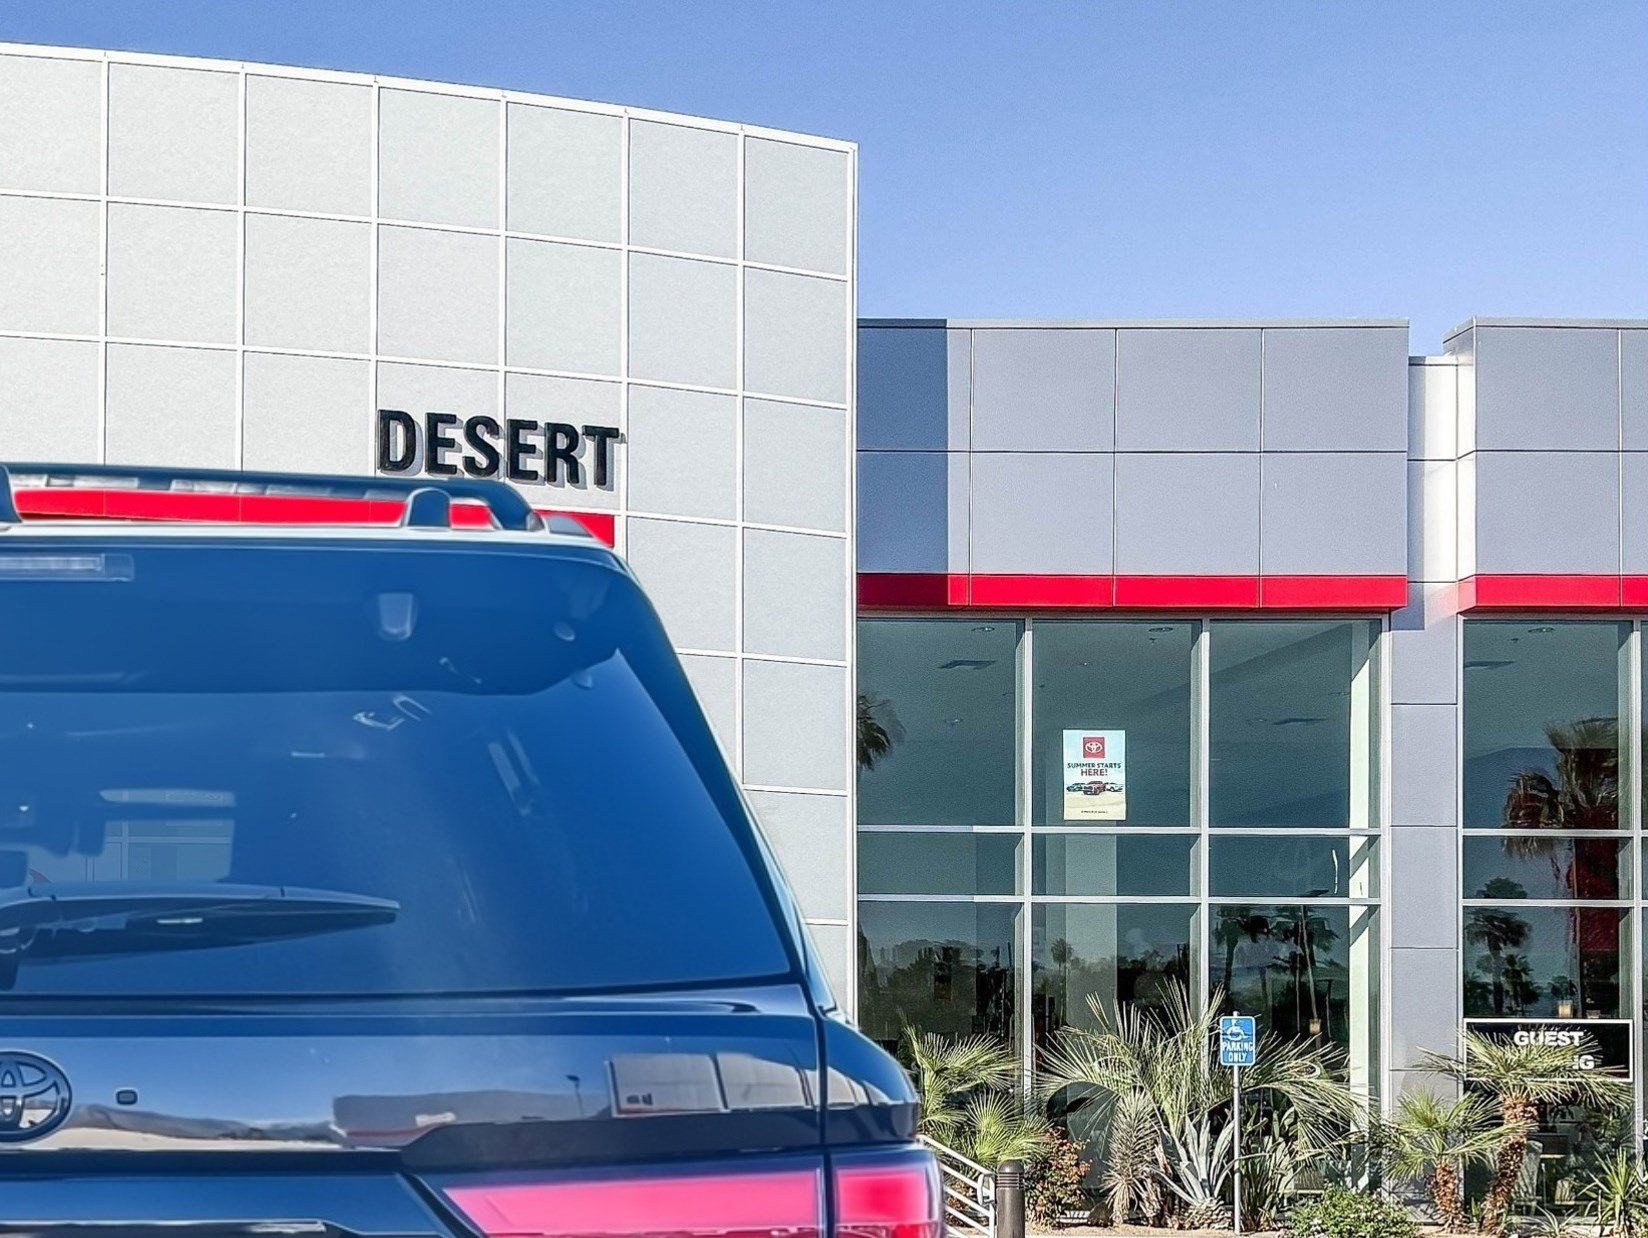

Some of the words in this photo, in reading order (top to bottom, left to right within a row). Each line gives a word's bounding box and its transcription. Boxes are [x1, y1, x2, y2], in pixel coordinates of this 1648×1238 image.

[377, 409, 621, 491] DESERT
[1080, 768, 1108, 776] HERE!
[1513, 1030, 1584, 1047] GUEST
[1222, 1041, 1254, 1052] PARKING
[1228, 1052, 1248, 1063] ONLY
